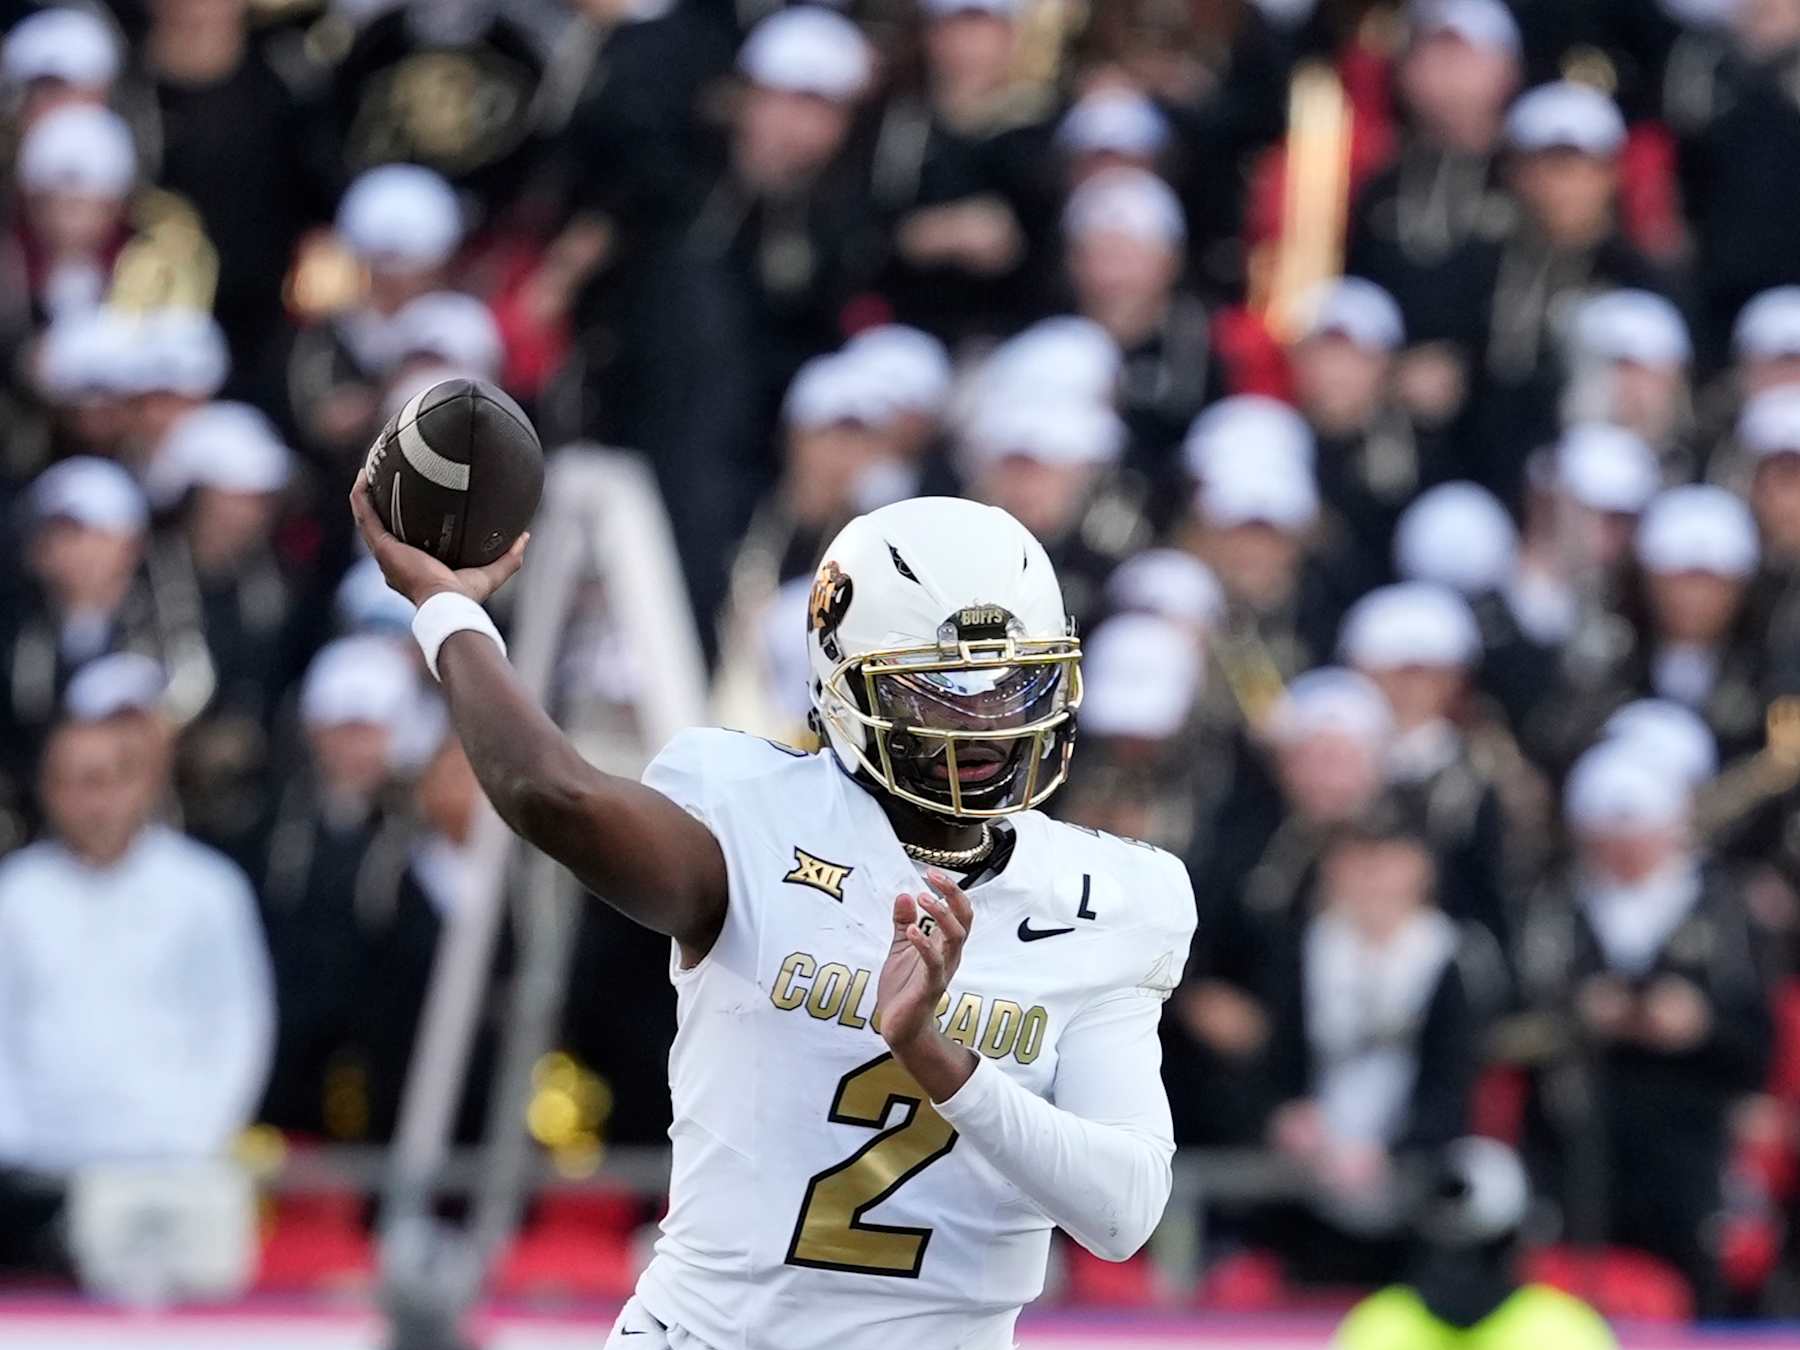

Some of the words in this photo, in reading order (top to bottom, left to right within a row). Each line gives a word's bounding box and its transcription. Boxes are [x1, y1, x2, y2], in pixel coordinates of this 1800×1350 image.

[961, 609, 1003, 626] BUFFS
[783, 846, 854, 903] XII
[1077, 873, 1097, 920] L
[770, 952, 1048, 1065] COLADO
[784, 1048, 960, 1279] 2
